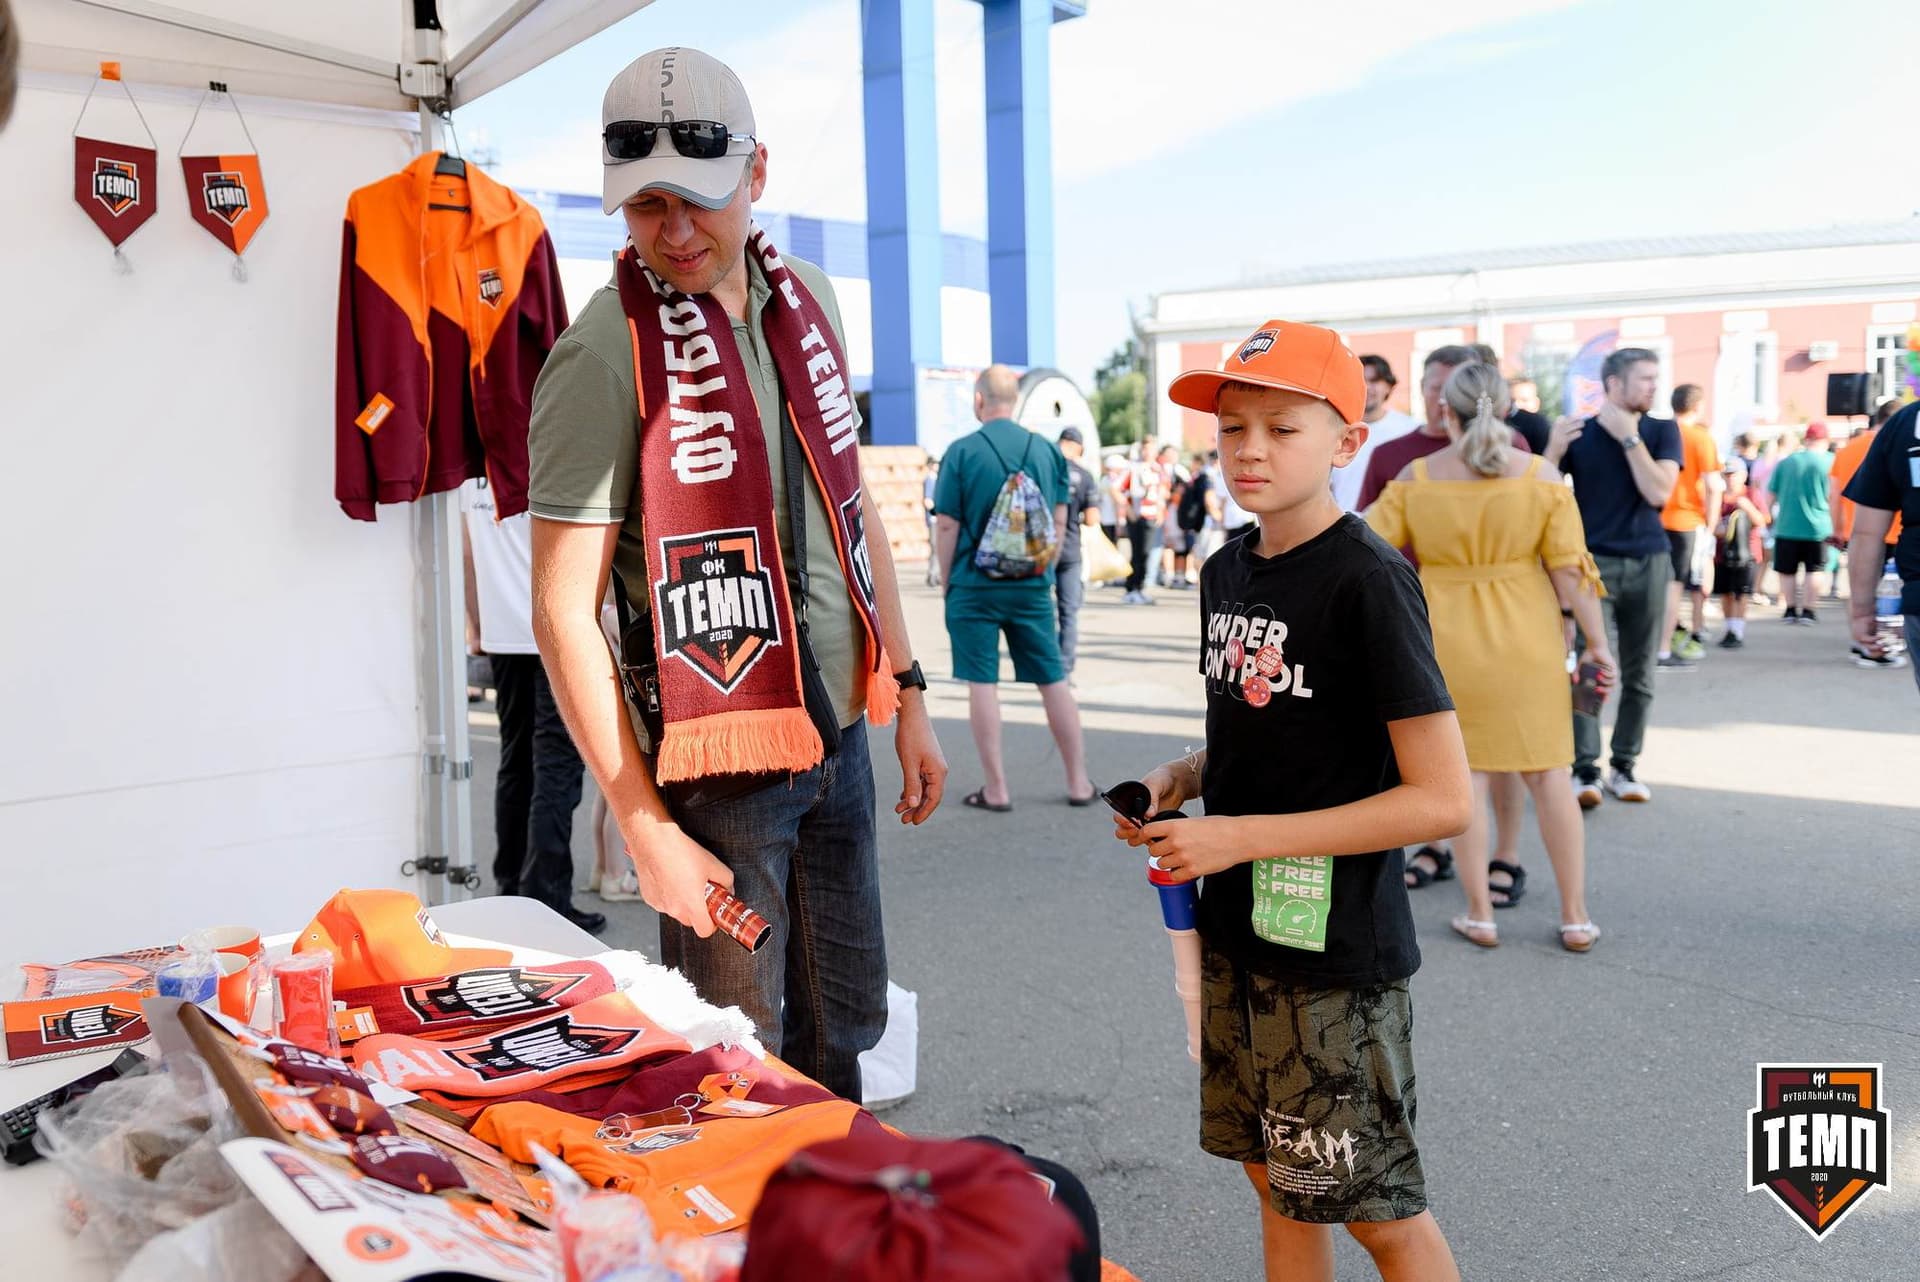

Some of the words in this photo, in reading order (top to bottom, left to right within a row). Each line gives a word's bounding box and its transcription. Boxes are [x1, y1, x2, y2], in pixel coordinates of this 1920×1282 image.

[98, 174, 135, 199] ТЕМП
[207, 187, 247, 208] ТЕМП
[800, 322, 857, 457] ТЕМП
[701, 558, 726, 576] ФК
[667, 576, 769, 640] ТЕМП
[709, 629, 733, 642] 2020
[1208, 612, 1288, 654] UNDER
[1271, 863, 1326, 884] FREE
[1270, 880, 1325, 900] FREE
[456, 972, 534, 1015] ТЕМП
[71, 1007, 109, 1038] ТЕМП
